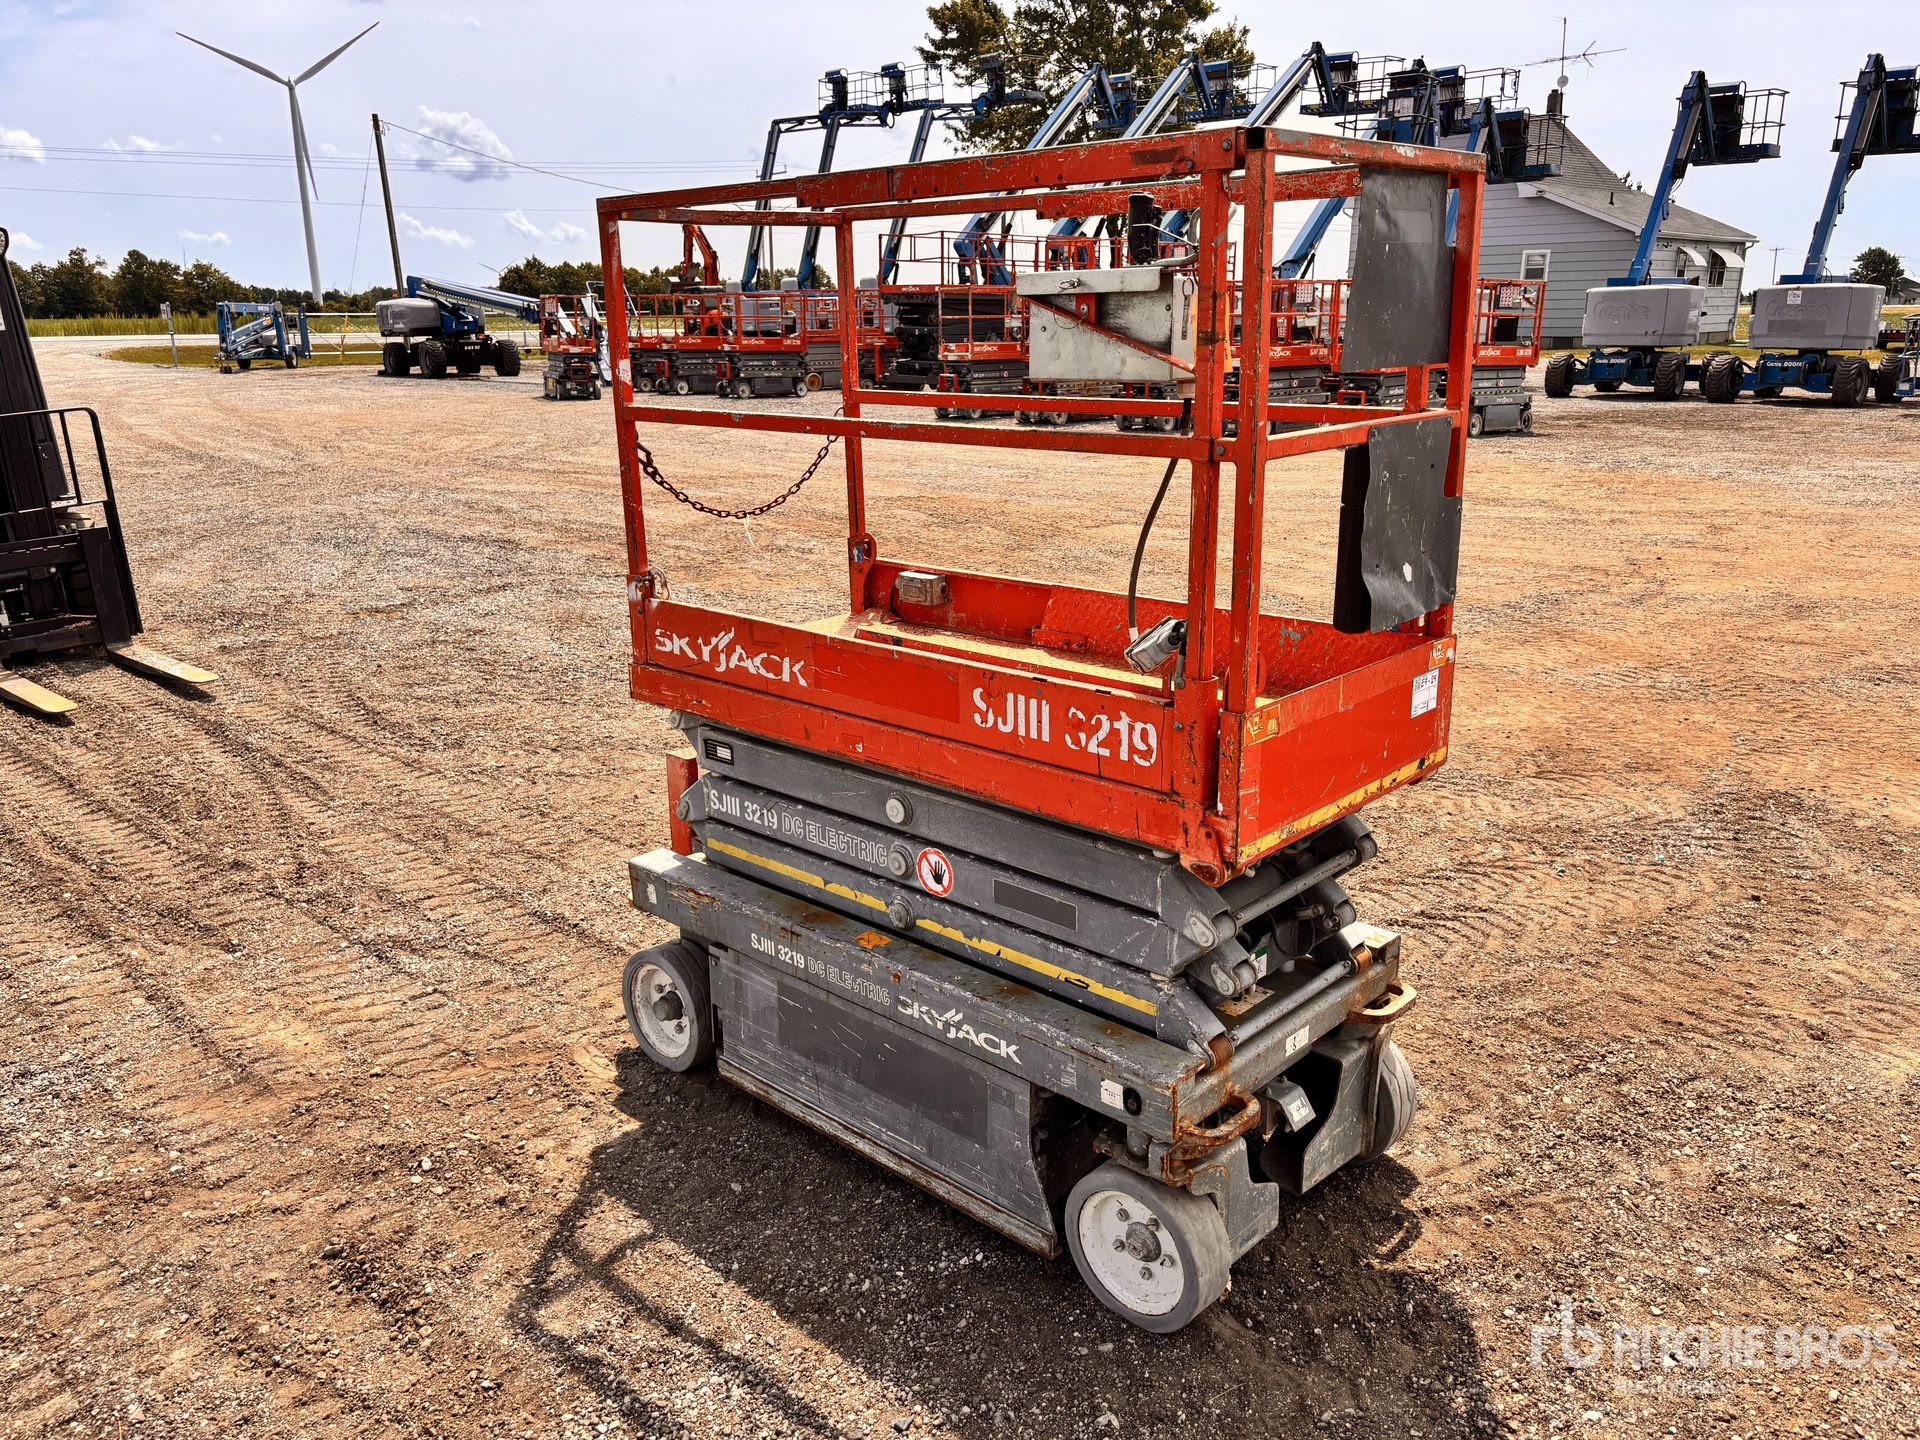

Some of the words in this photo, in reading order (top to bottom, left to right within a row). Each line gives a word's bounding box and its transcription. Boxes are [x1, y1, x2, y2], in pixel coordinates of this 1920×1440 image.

[973, 344, 998, 352] SKYJACK
[1269, 347, 1291, 359] KYJACK
[654, 626, 808, 687] SKYJACK
[972, 687, 1050, 743] SJIII
[710, 789, 741, 818] SJIII
[743, 801, 778, 829] 3219
[781, 812, 804, 839] DC
[805, 820, 888, 867] ELECTRIC
[750, 932, 776, 957] SJIII
[777, 944, 805, 969] 3219
[807, 956, 826, 978] DC
[826, 964, 891, 1006] ELECTRIC
[897, 995, 1023, 1065] SKYJACK
